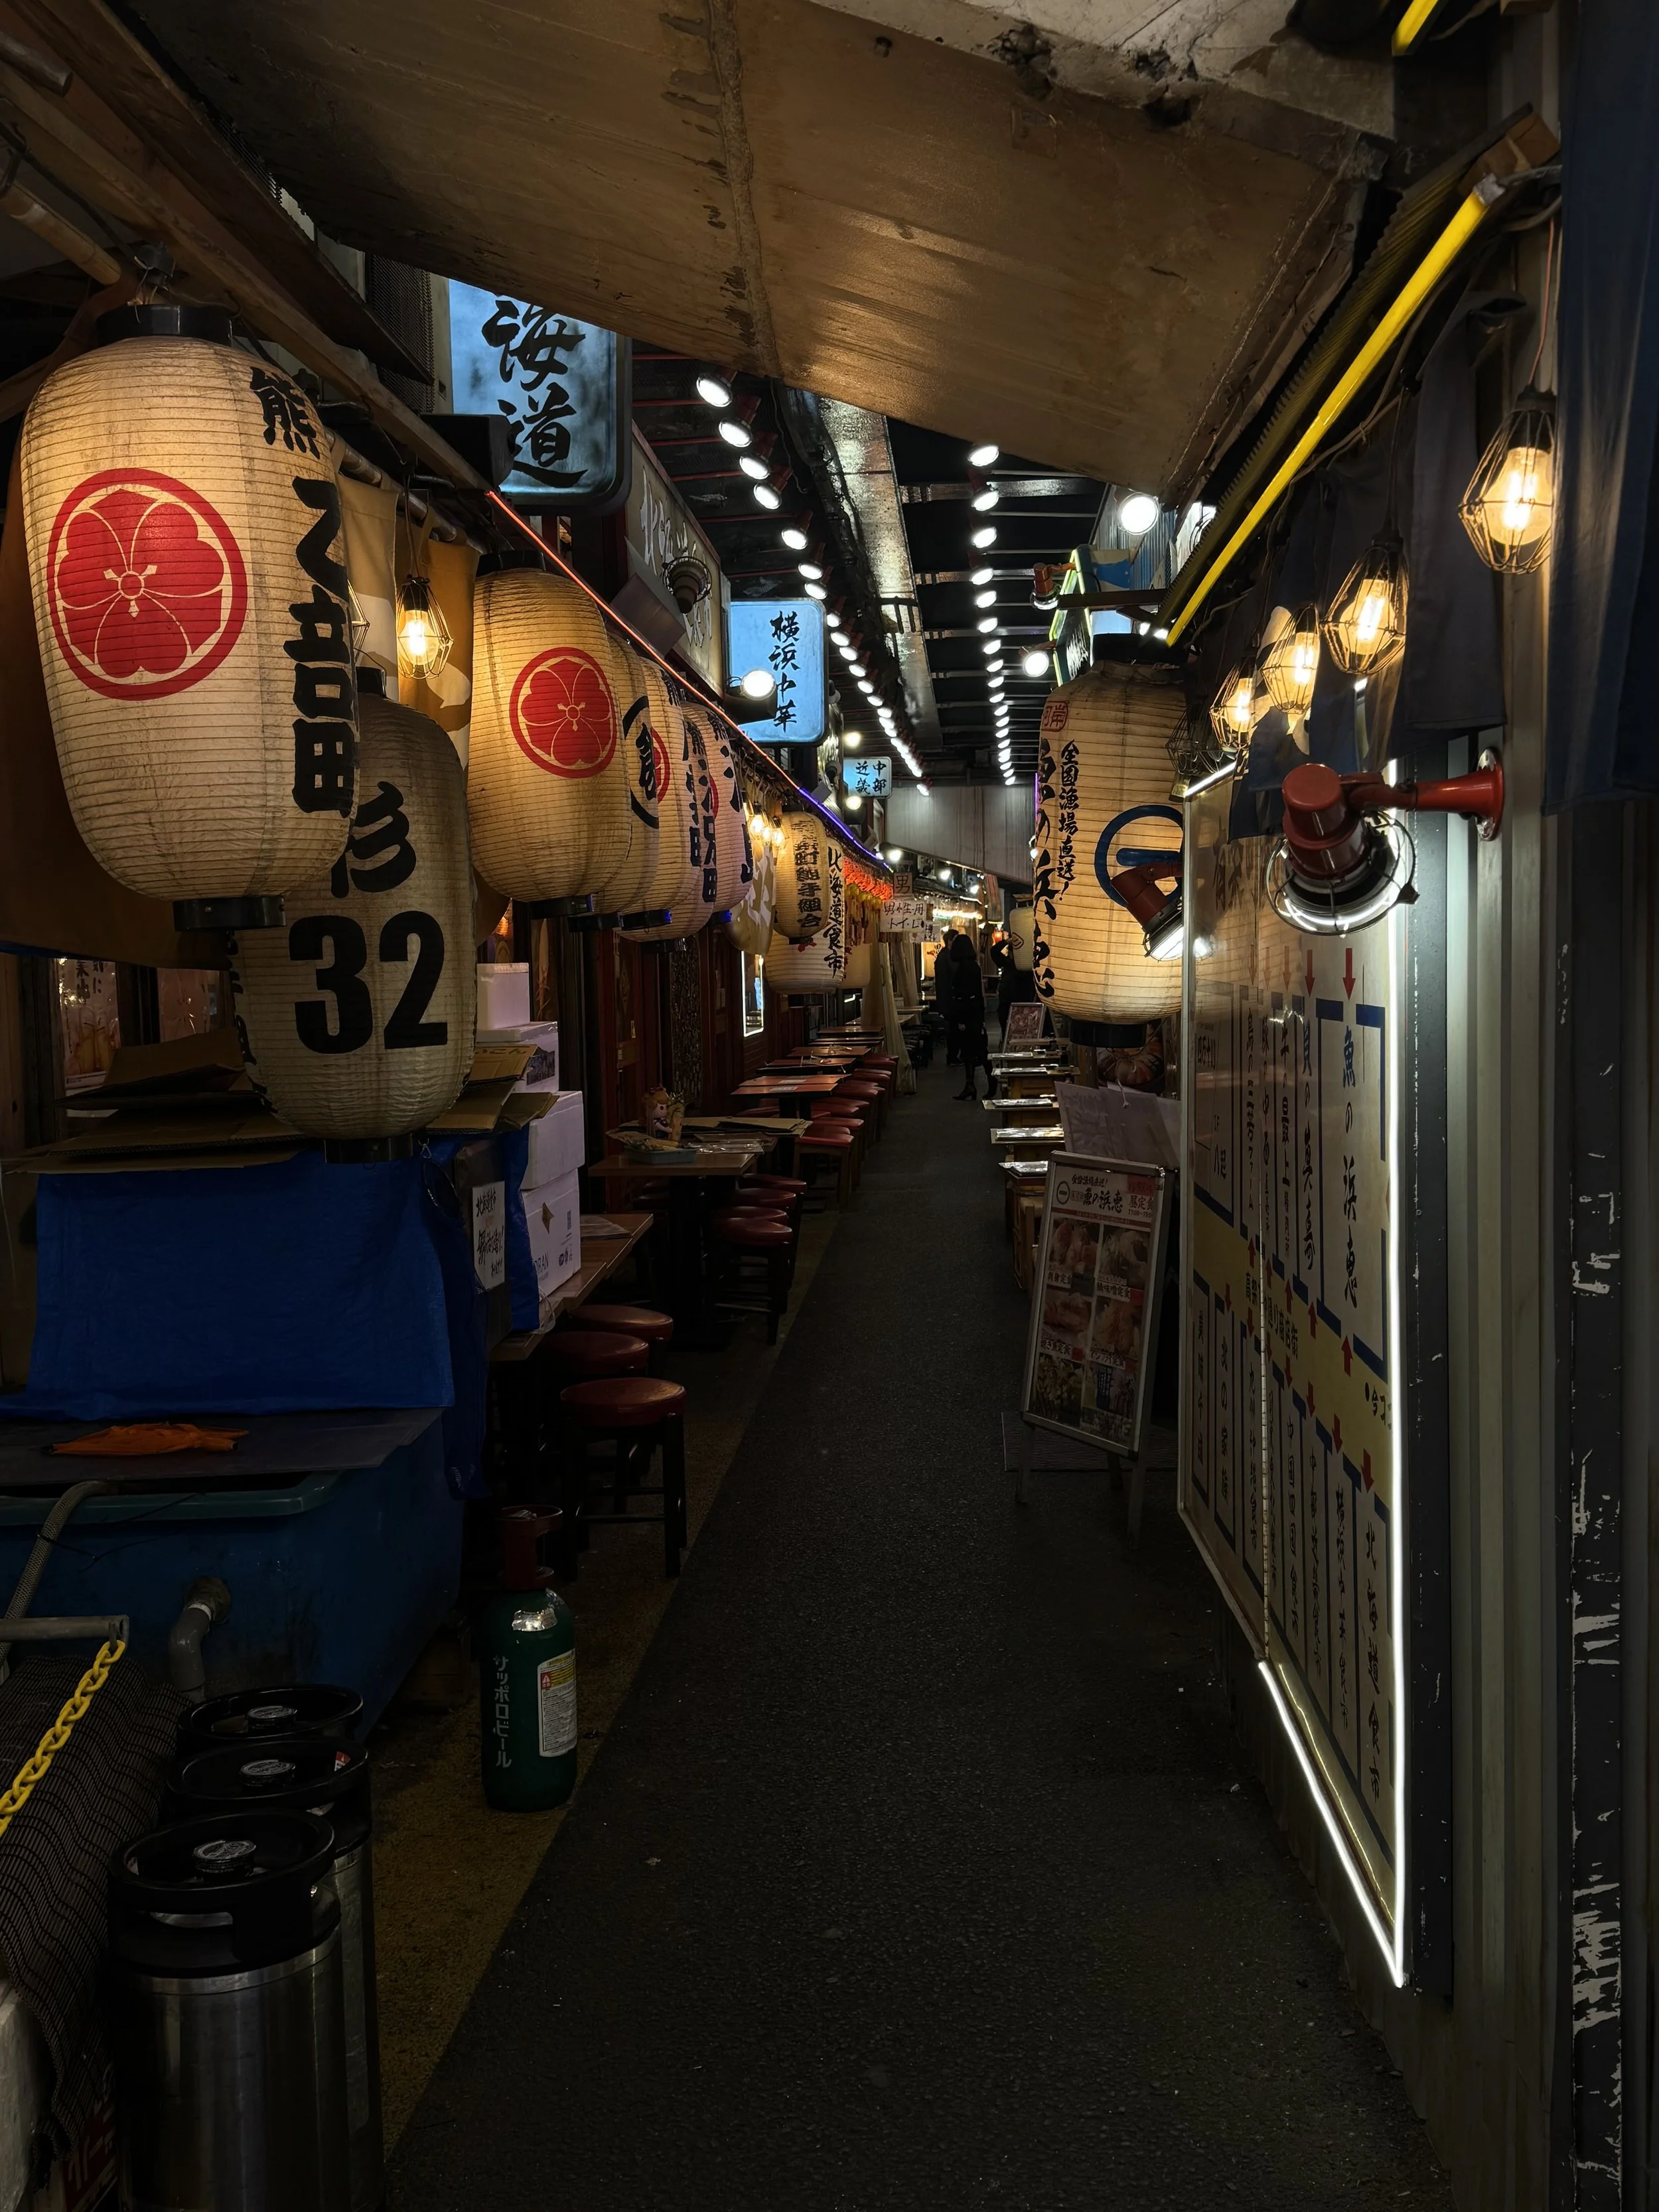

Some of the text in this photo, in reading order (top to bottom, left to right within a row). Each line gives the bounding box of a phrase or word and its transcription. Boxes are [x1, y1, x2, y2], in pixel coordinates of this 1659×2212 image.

[896, 875, 910, 894] 男
[288, 911, 448, 1055] 32
[492, 1655, 512, 1769] サッポロビール
